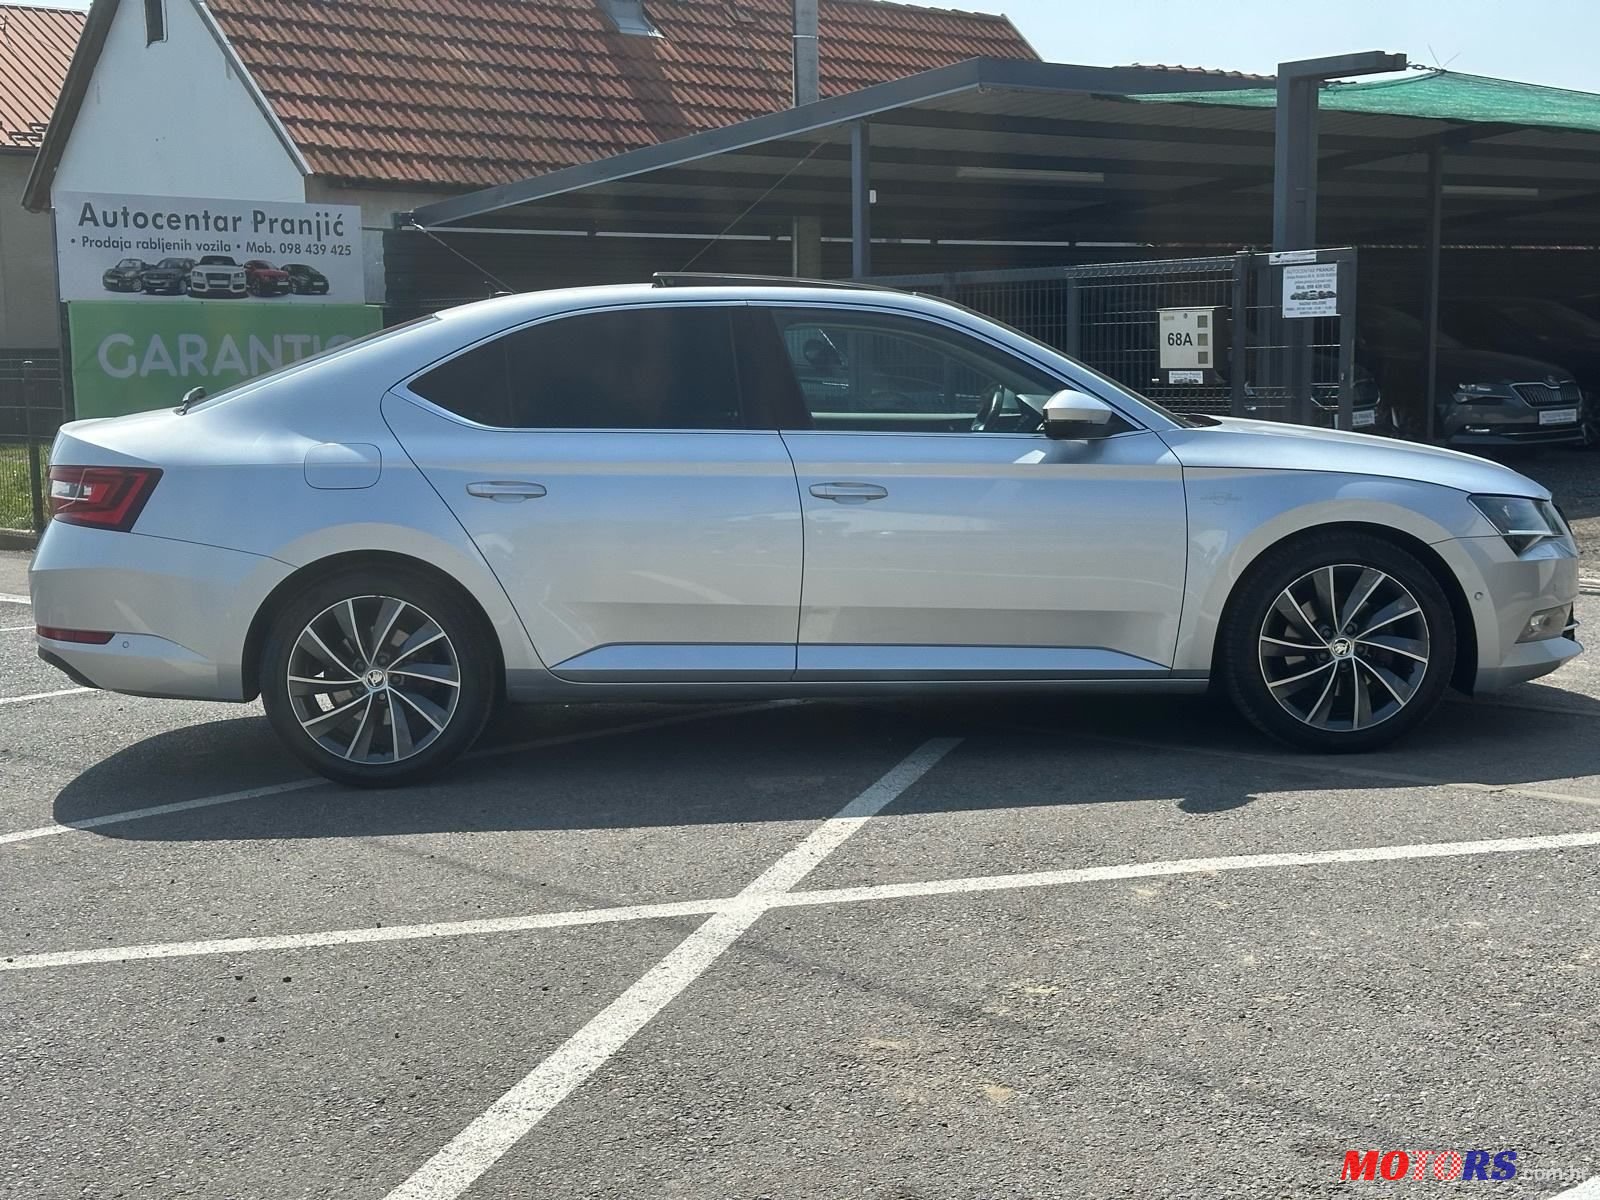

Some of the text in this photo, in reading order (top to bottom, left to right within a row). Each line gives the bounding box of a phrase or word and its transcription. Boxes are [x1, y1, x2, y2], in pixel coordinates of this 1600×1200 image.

[78, 202, 344, 242] Autocentar Pranjić
[81, 235, 352, 256] Prodaja rabljenih vozila Mob. 098 439 425
[1167, 332, 1193, 347] 68A
[97, 332, 352, 379] GARANT
